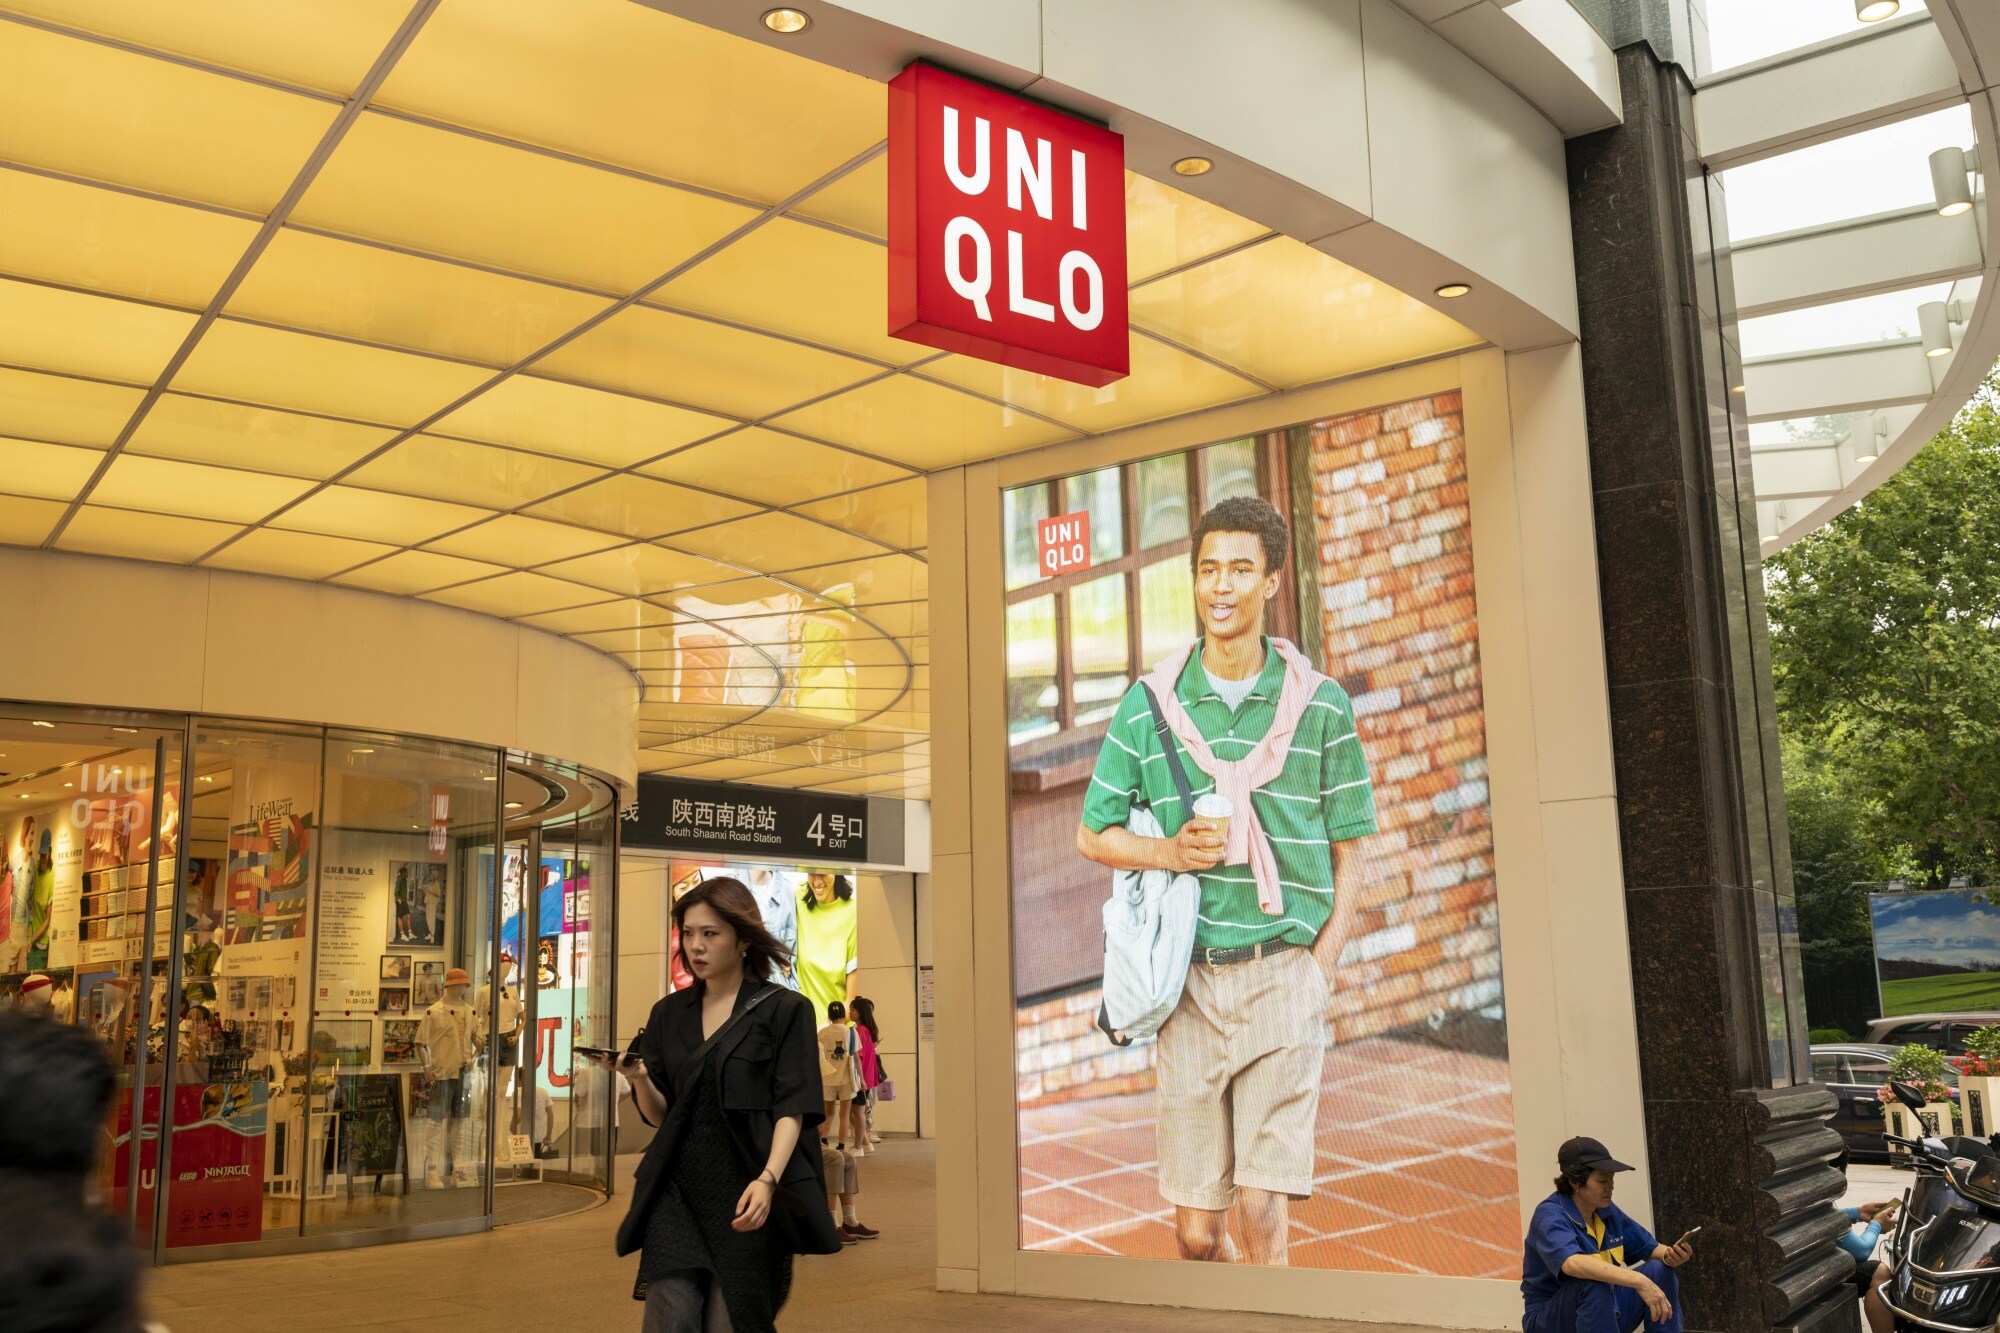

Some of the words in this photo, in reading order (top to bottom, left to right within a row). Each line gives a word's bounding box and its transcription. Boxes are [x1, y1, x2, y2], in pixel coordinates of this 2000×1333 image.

[943, 105, 1087, 231] UNI
[944, 215, 1104, 331] QLO
[1044, 520, 1080, 545] UNI
[1046, 543, 1084, 571] QLO
[250, 799, 294, 823] LifeWear
[672, 798, 777, 832] 陕西南路站
[665, 825, 691, 838] South
[692, 827, 727, 840] Shaanxi
[729, 831, 751, 842] Road
[753, 832, 782, 844] Station
[828, 838, 848, 849] EXIT
[513, 1137, 525, 1146] 2F
[179, 1172, 198, 1181] LEGO
[200, 1165, 252, 1182] NINJAGO
